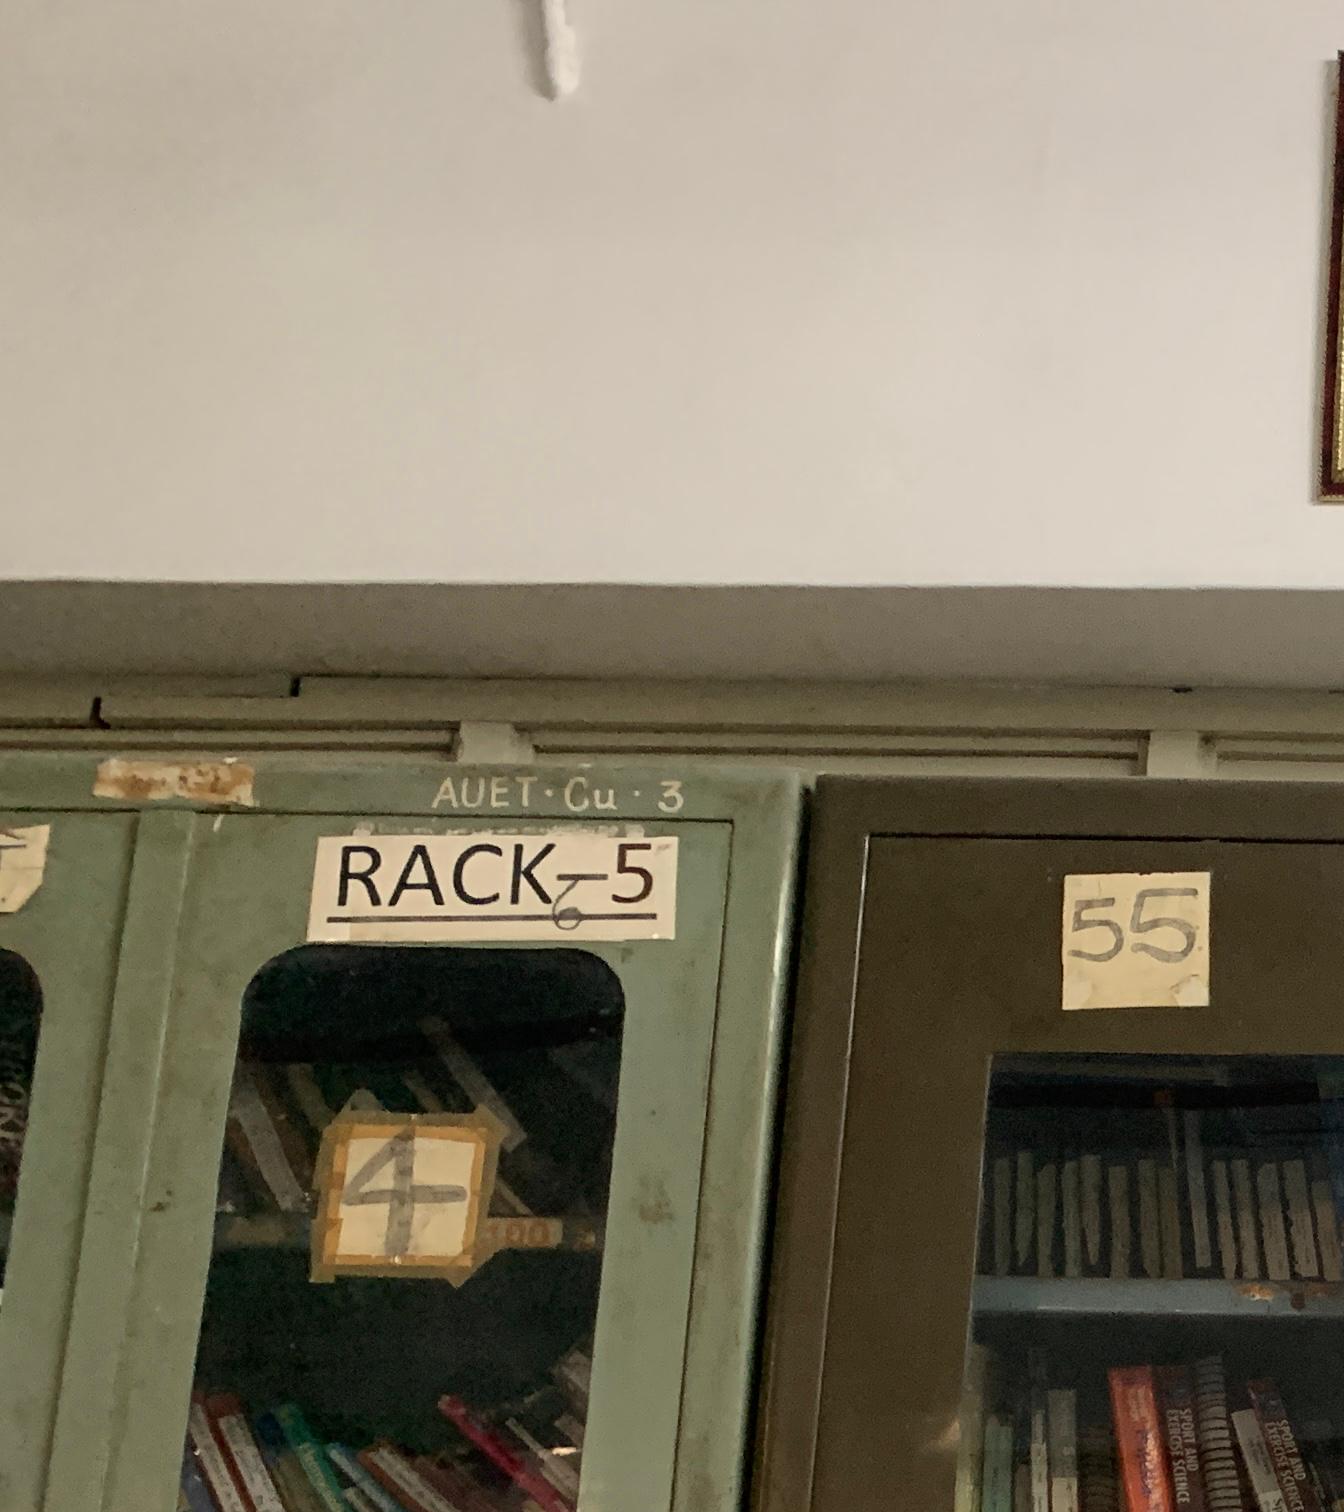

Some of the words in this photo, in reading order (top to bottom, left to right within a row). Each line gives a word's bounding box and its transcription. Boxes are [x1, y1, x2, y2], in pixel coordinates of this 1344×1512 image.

[337, 843, 653, 906] RACK-5
[1068, 887, 1199, 963] 55
[343, 1129, 468, 1256] 4
[1166, 1409, 1184, 1457] EXERCISE
[1179, 1407, 1195, 1444] SPORT
[1277, 1419, 1299, 1456] SPORT
[1290, 1456, 1306, 1481] AND
[1172, 1458, 1191, 1504] SCIENCE
[1185, 1447, 1199, 1472] AND
[1265, 1421, 1289, 1467] EXERCISE
[1279, 1467, 1305, 1512] SCIENCE
